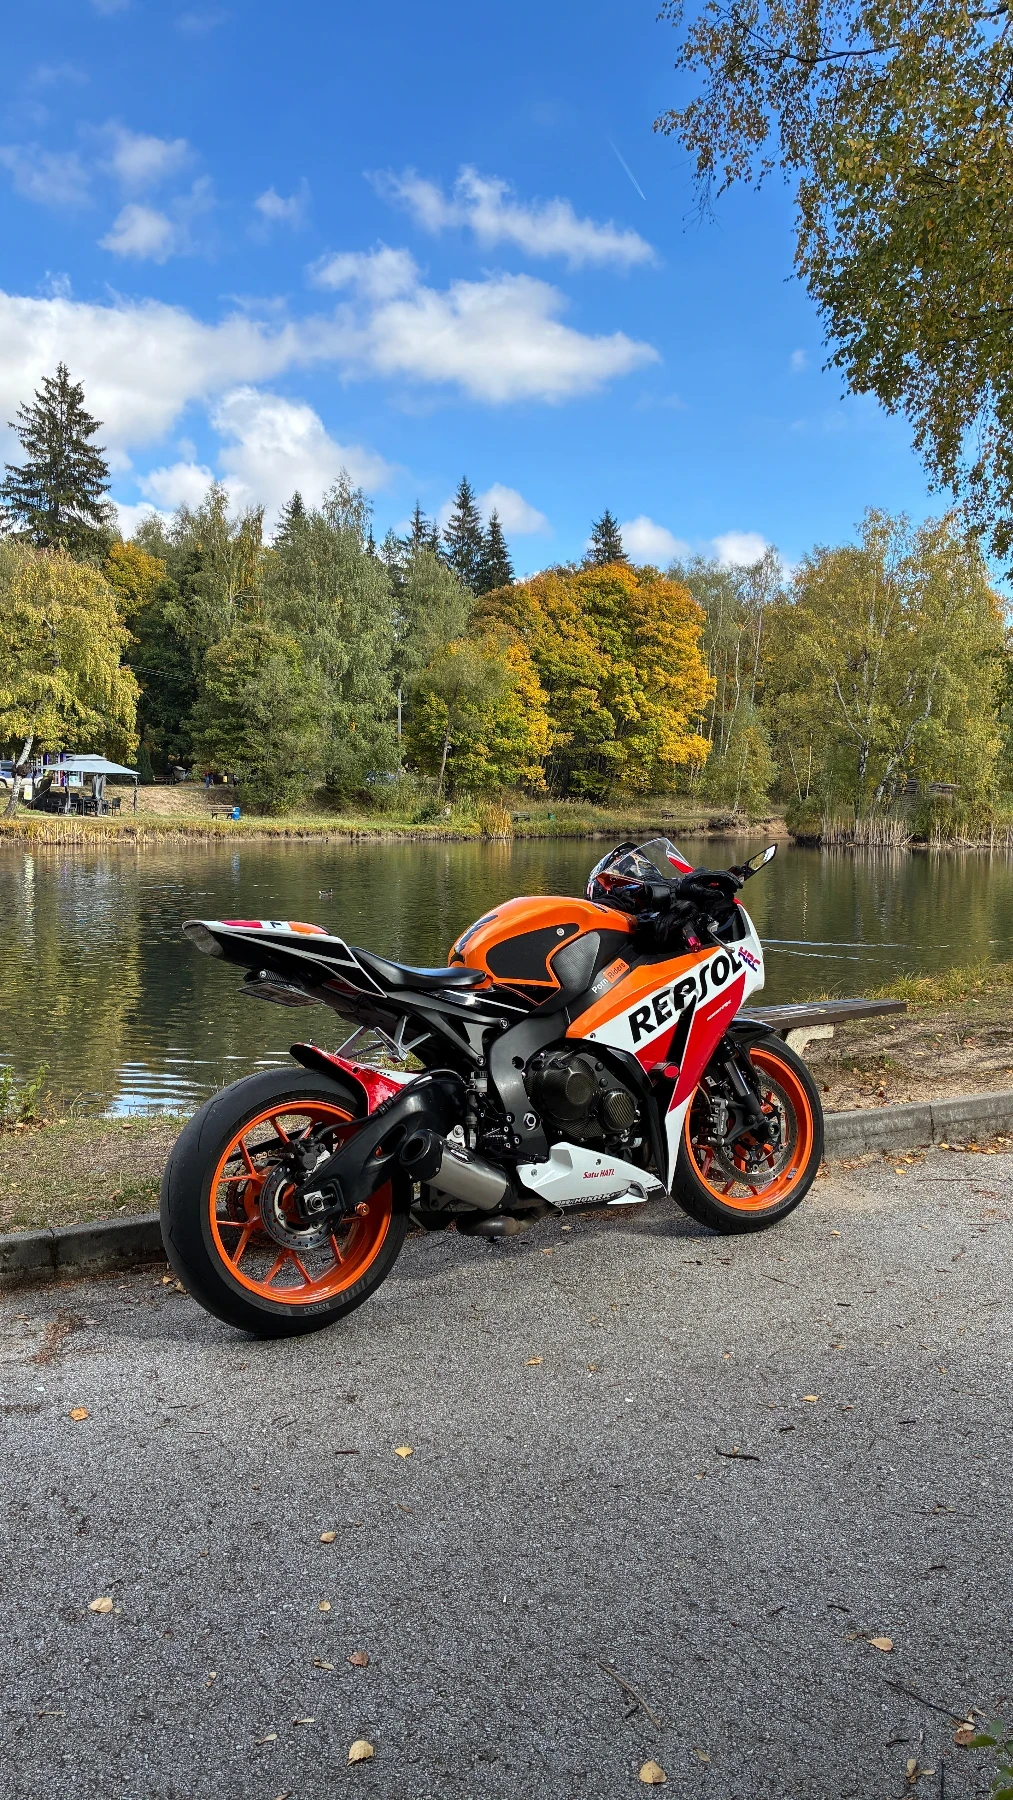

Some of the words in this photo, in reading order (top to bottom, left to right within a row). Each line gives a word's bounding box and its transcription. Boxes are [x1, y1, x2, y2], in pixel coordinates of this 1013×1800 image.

[738, 946, 761, 971] HRC
[591, 978, 609, 994] Porn
[607, 962, 626, 979] Riders
[628, 951, 743, 1044] REPSOL
[583, 1171, 599, 1179] Satu
